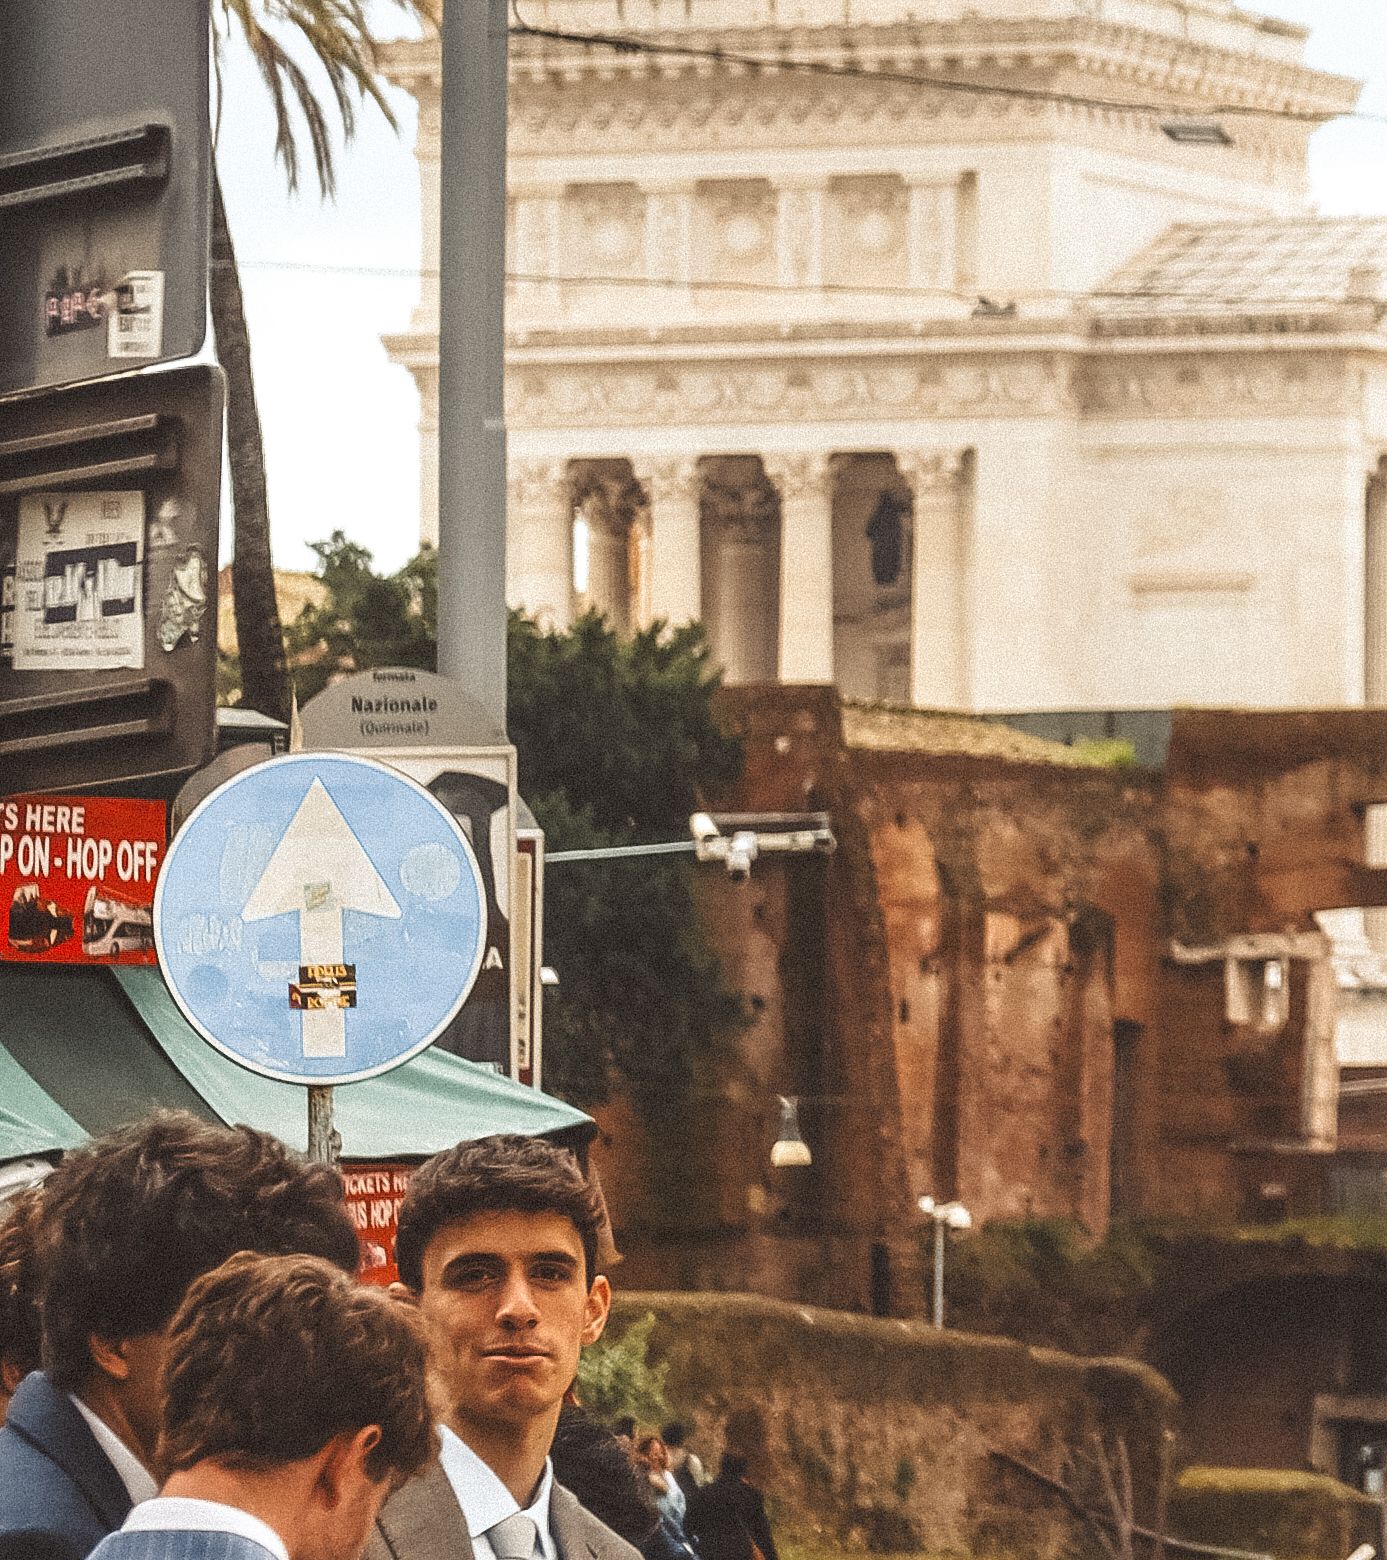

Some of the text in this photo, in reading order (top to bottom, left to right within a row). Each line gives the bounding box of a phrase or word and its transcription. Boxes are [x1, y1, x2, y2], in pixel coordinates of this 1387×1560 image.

[351, 696, 438, 714] Nazionale
[25, 803, 86, 835] HERE
[18, 834, 50, 878] ON
[66, 837, 113, 881] HOP
[116, 839, 158, 883] OFF
